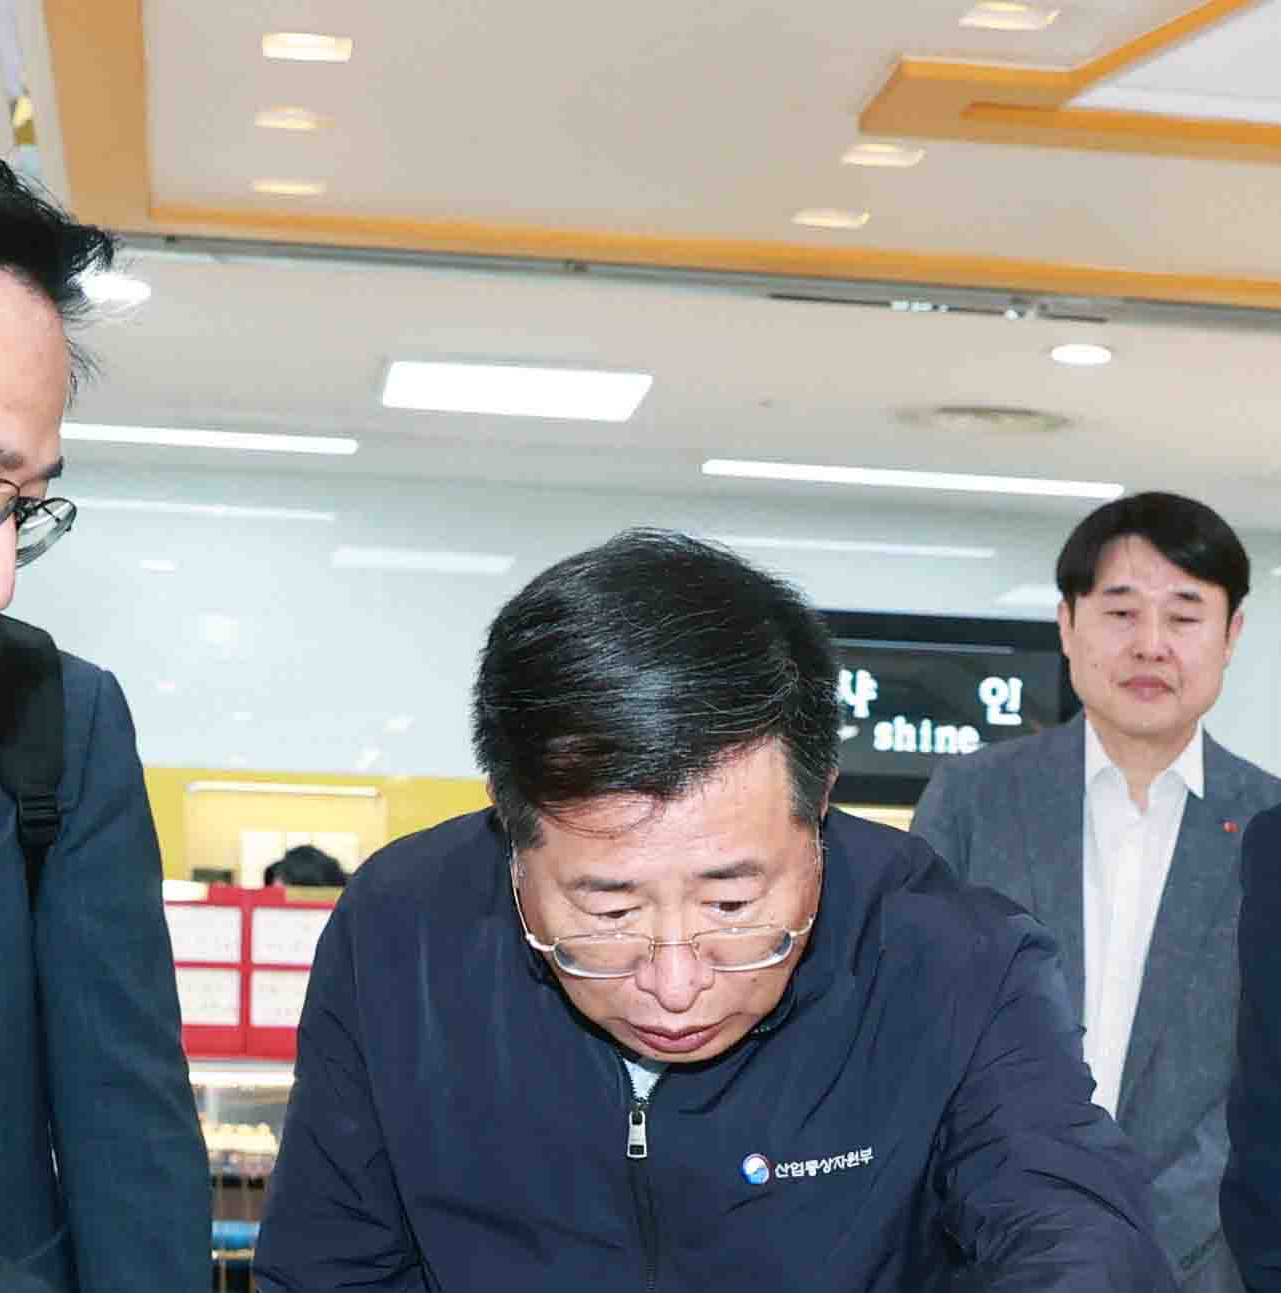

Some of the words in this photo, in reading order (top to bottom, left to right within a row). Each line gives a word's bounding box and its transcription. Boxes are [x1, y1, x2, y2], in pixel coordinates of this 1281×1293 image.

[978, 676, 1023, 726] 인
[873, 715, 982, 755] shine
[774, 1147, 875, 1179] 산업통상자원부
